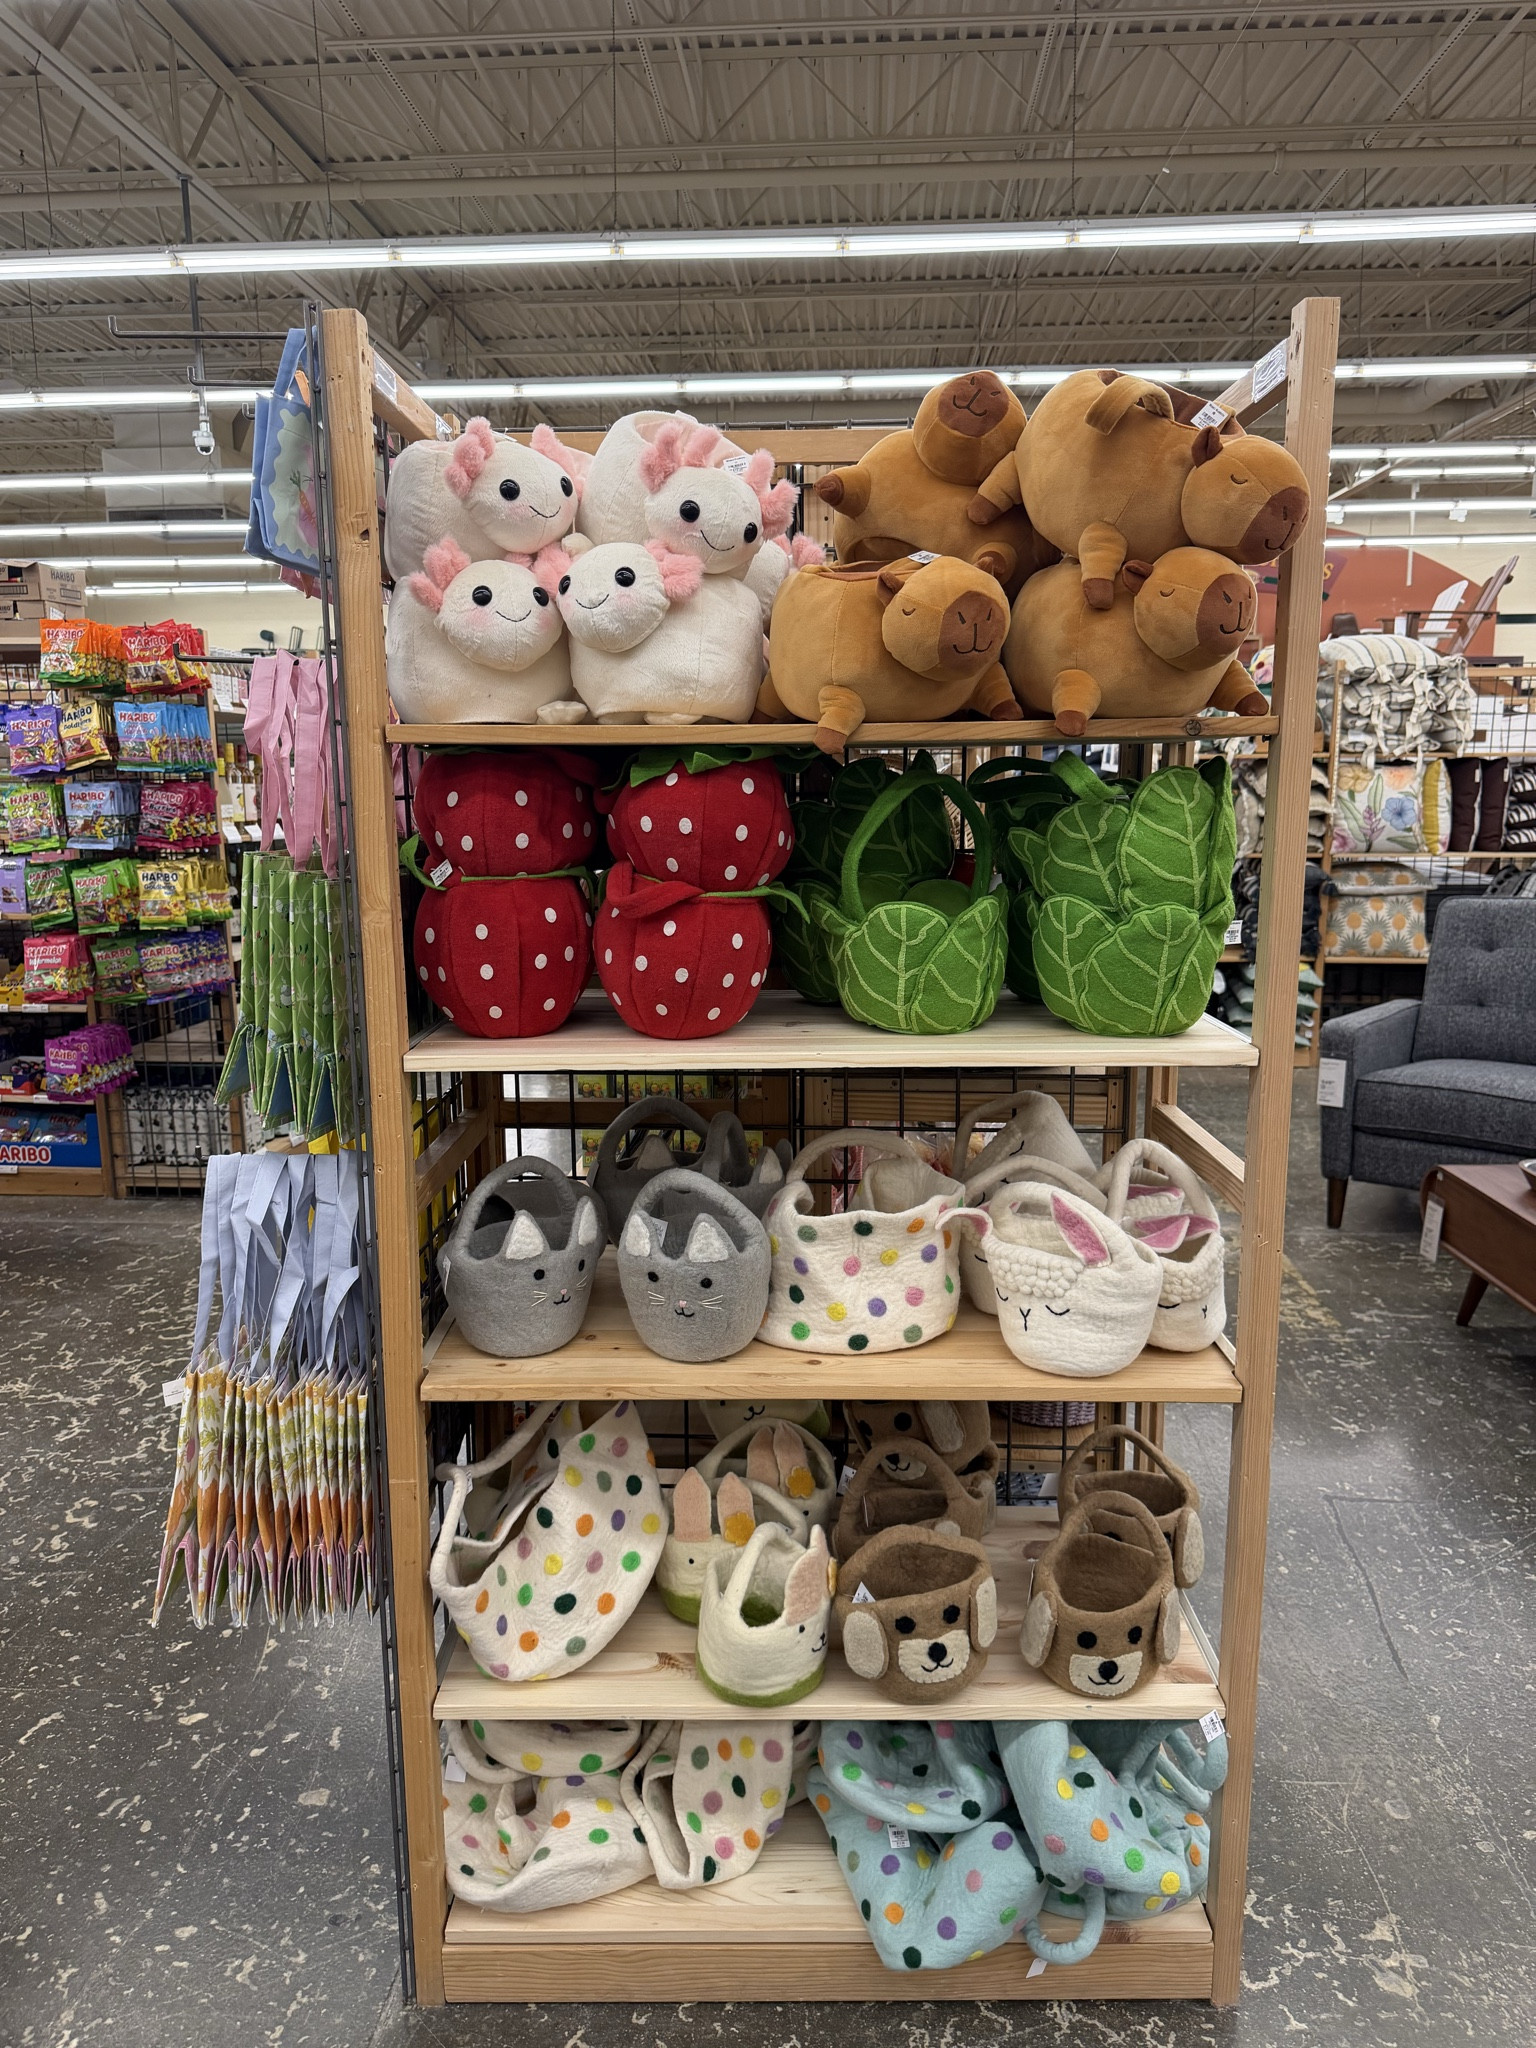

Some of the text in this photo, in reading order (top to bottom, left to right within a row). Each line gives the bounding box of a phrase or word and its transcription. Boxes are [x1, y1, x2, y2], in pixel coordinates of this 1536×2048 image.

[51, 570, 75, 582] HARIBO
[46, 629, 83, 639] HARIBO
[129, 636, 167, 648] HARIBO
[119, 711, 156, 722] HARIBO
[11, 719, 51, 731] HARIBO
[10, 791, 47, 805] HARIBO
[69, 791, 105, 801] HARIBO
[146, 790, 183, 804] HARIBO
[29, 867, 61, 882] HARIBO
[75, 876, 108, 888] HARIBO
[28, 946, 65, 958] HARIBO
[96, 948, 132, 961] HARIBO
[142, 945, 179, 958] HARIBO
[49, 1049, 77, 1060] HARIBO
[0, 1146, 50, 1162] ARIBO
